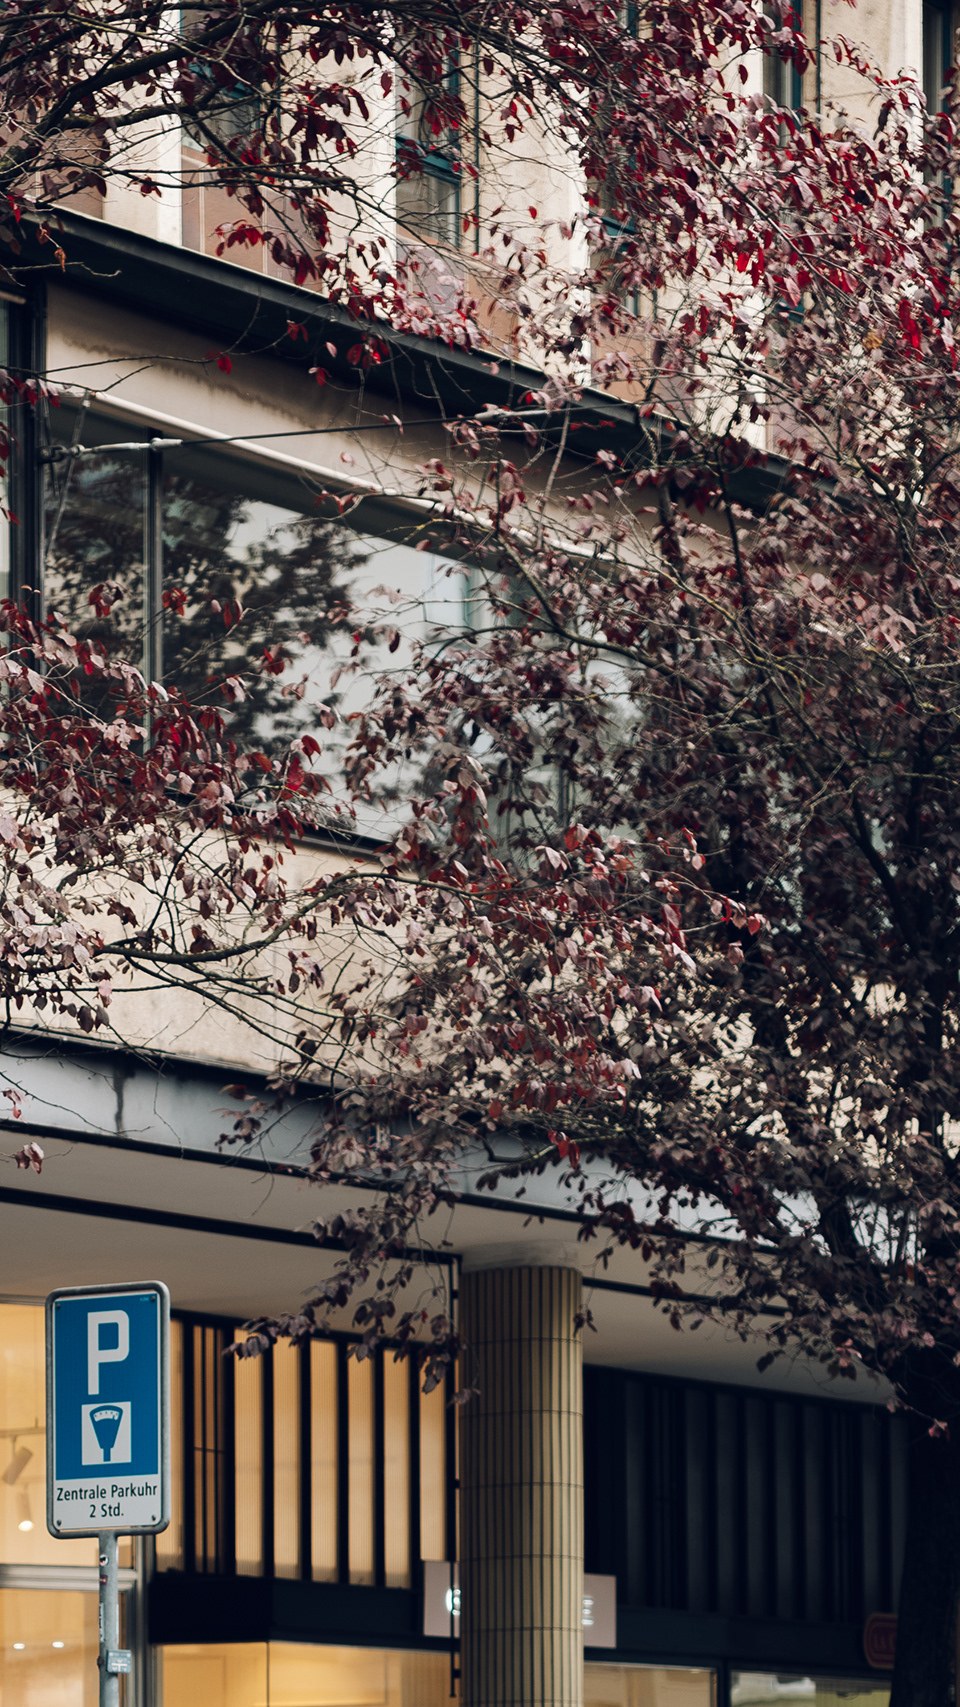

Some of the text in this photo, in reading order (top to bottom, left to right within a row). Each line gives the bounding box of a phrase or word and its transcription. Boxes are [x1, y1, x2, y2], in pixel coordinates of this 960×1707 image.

[87, 1310, 130, 1395] P
[56, 1482, 157, 1502] Zentrale Parkuhr
[89, 1503, 124, 1518] 2 Std.
